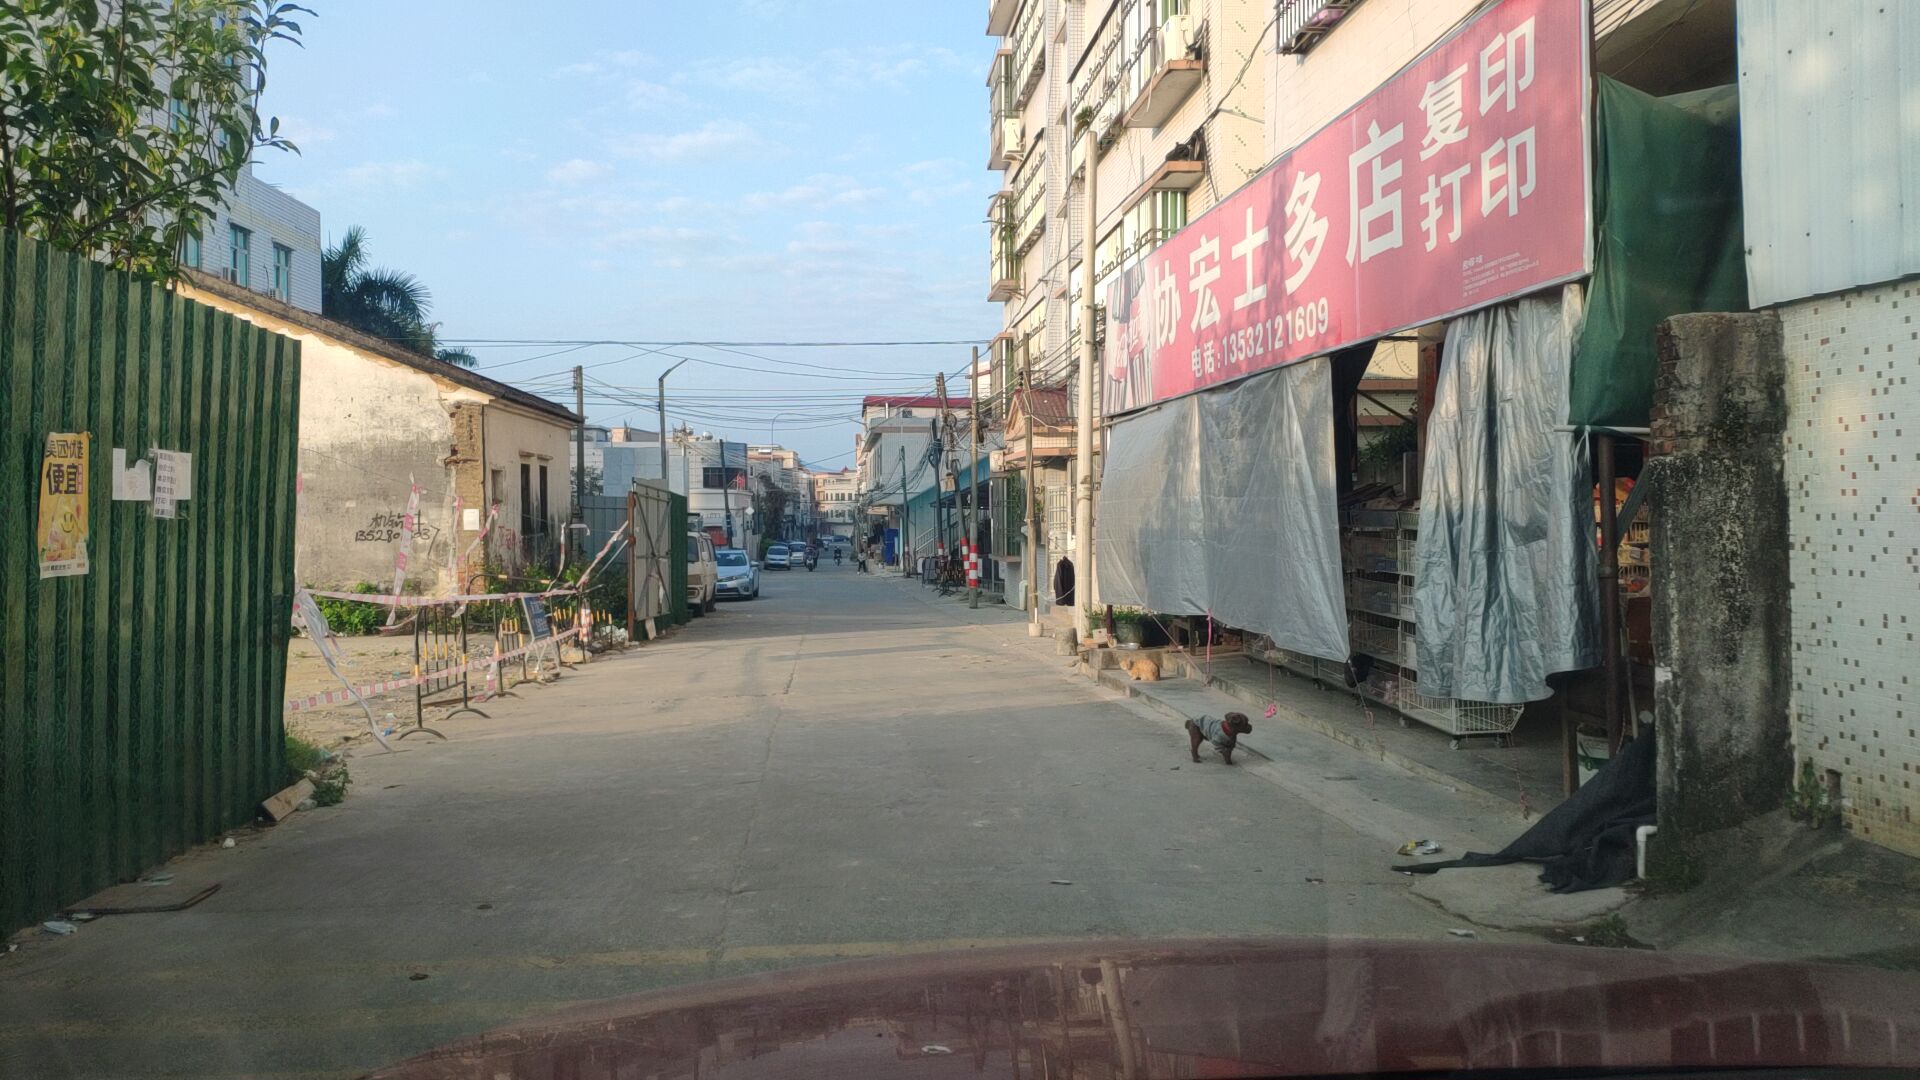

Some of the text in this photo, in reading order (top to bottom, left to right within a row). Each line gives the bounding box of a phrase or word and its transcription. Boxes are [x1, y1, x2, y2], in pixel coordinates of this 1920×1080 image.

[1419, 15, 1537, 162] 复印
[1152, 120, 1405, 352] 协宏士多店
[1419, 125, 1537, 253] 打印
[46, 462, 77, 496] 便宜
